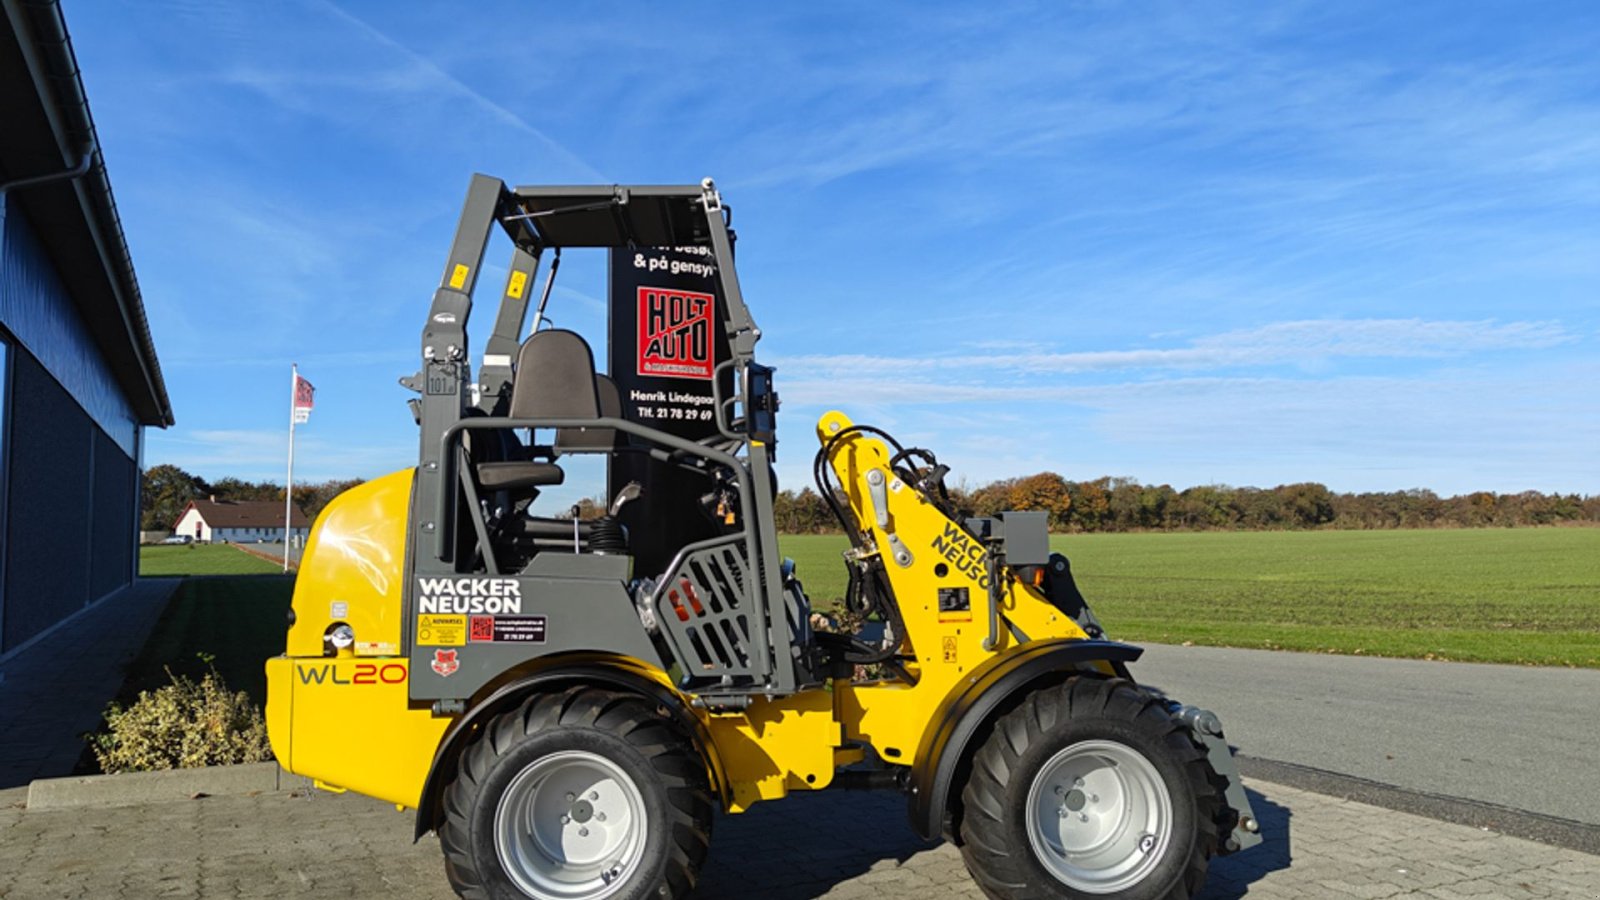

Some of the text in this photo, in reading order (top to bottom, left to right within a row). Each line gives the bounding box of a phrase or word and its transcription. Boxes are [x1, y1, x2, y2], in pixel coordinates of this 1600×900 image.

[634, 253, 647, 268] &
[649, 255, 668, 272] på
[647, 293, 708, 339] HOLT
[643, 317, 708, 362] AUTO
[630, 390, 667, 402] Henrik
[657, 408, 668, 418] 21
[670, 408, 683, 419] 78
[685, 409, 699, 420] 29
[700, 410, 712, 420] 69
[419, 578, 521, 596] WACKER
[419, 596, 521, 614] NEUSON
[297, 664, 407, 685] WL20
